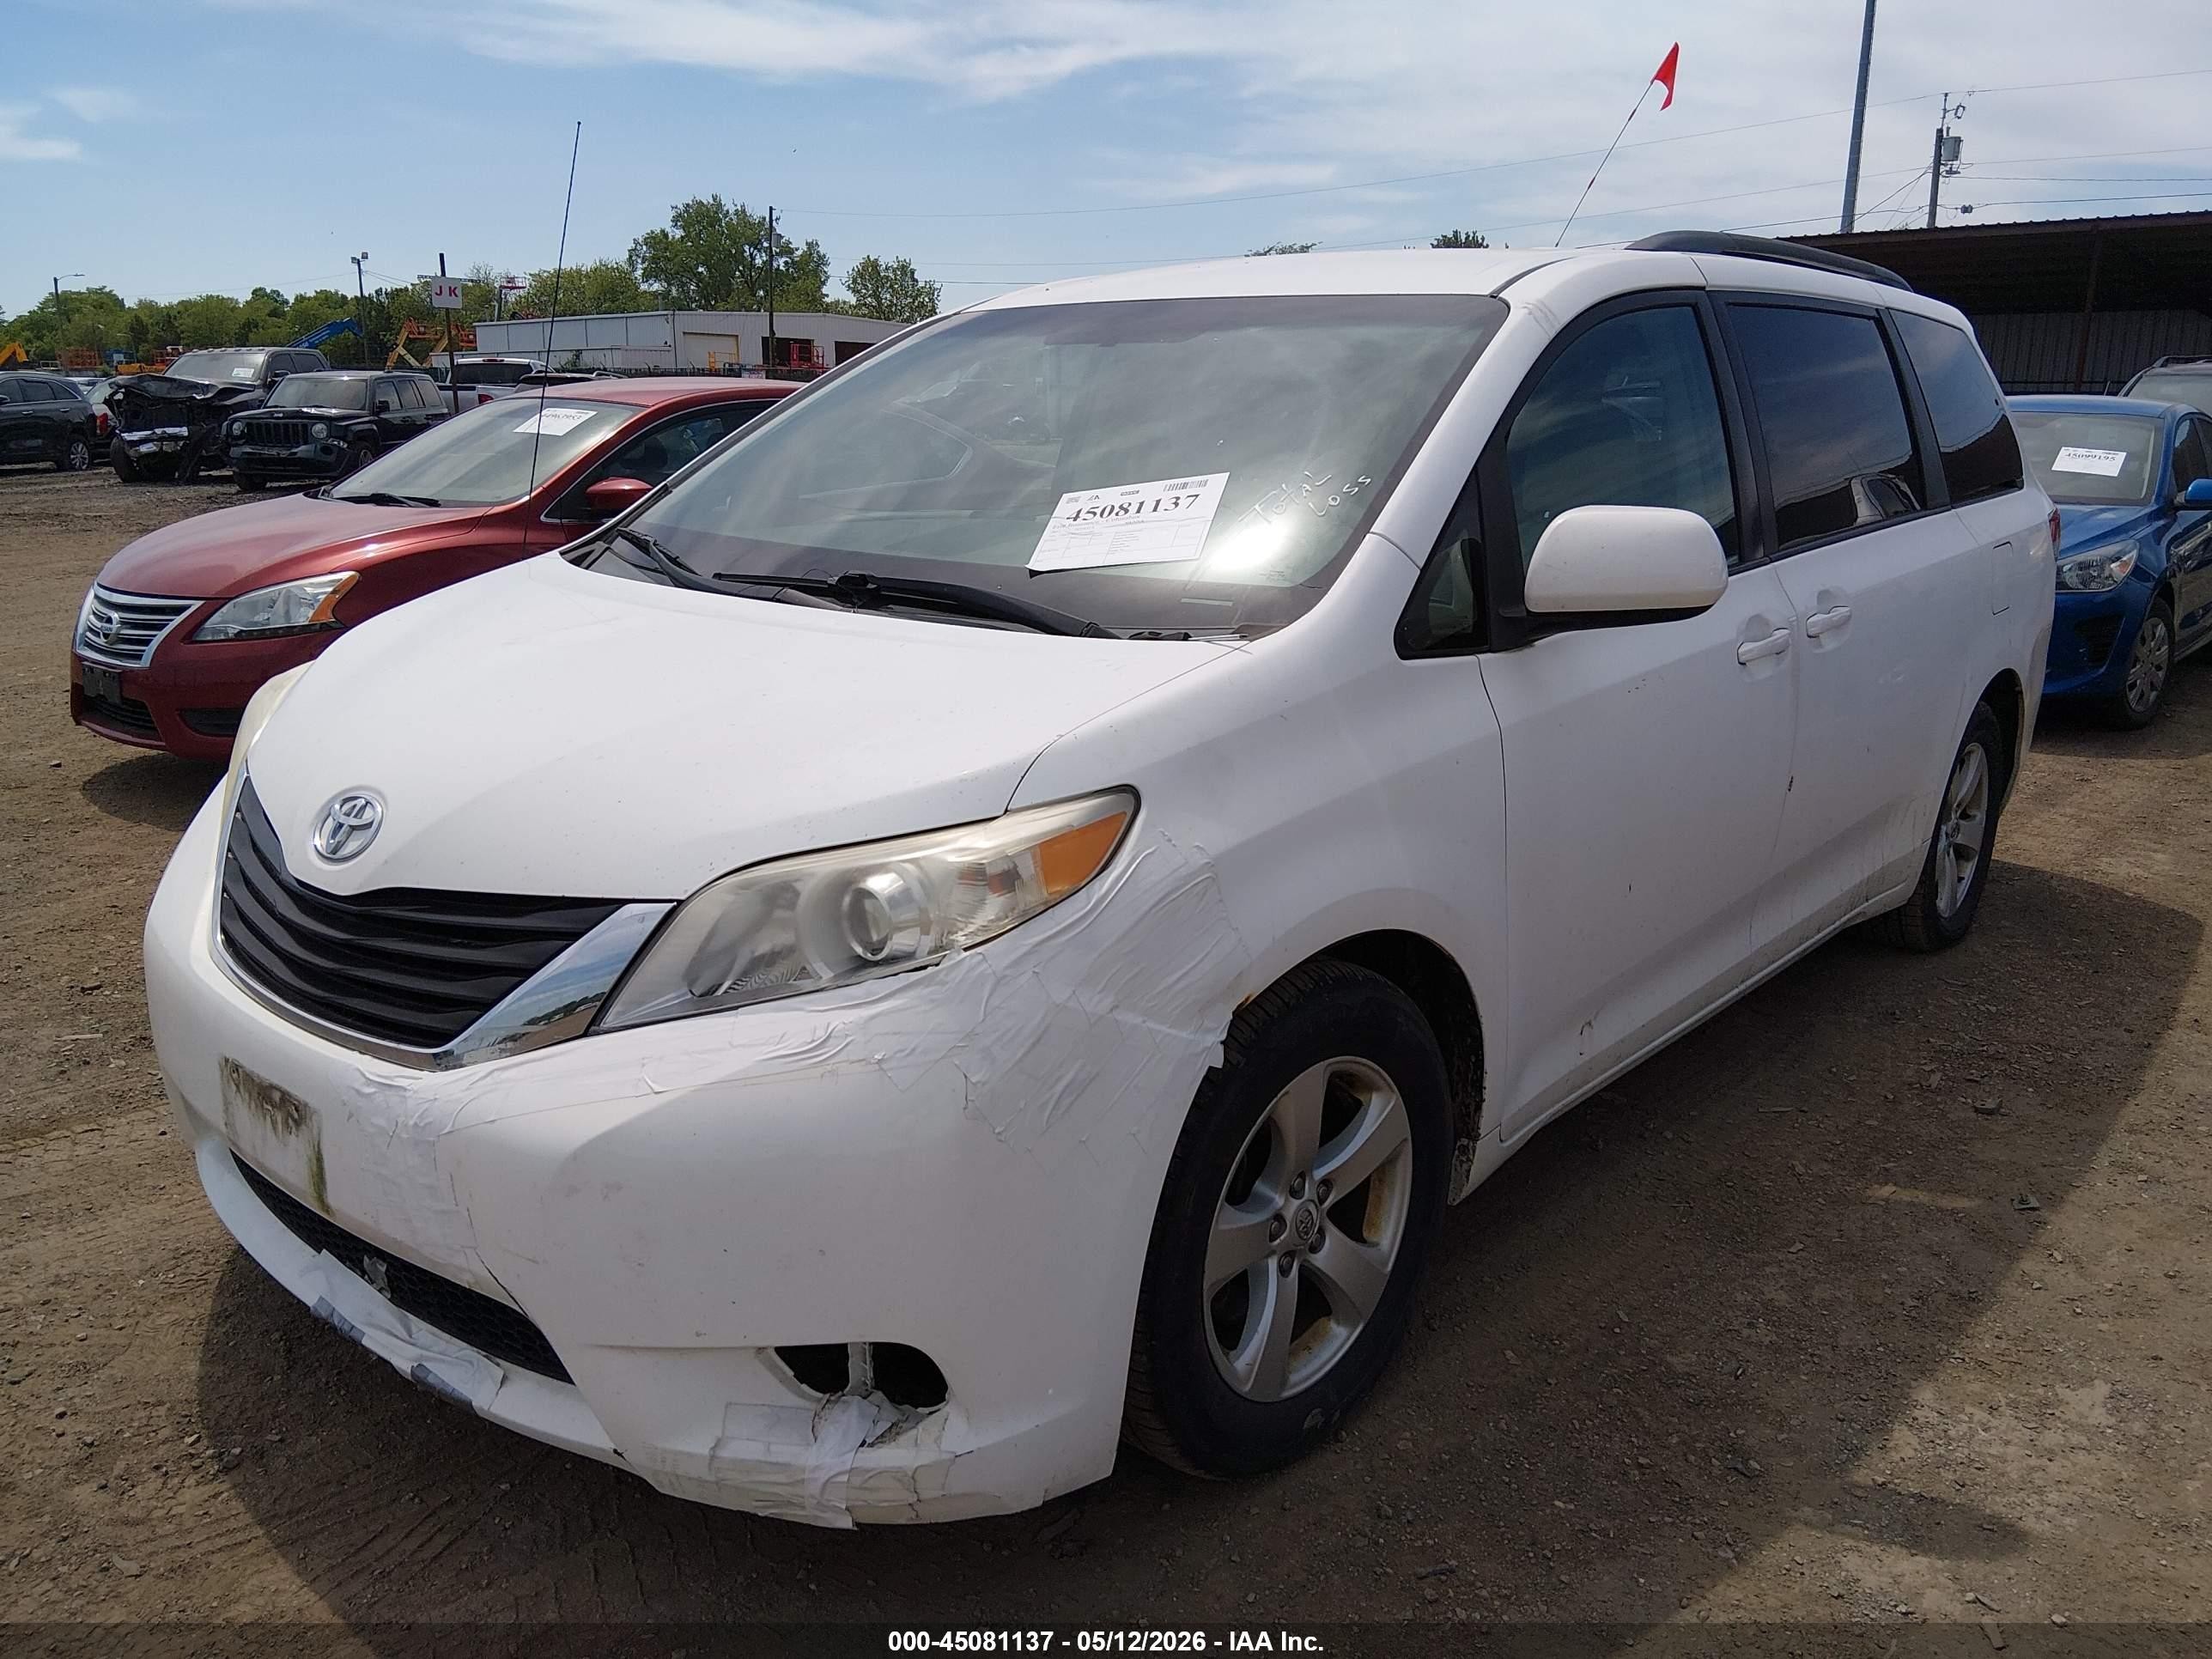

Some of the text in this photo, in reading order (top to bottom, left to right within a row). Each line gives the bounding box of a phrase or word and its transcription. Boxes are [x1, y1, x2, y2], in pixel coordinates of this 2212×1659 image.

[434, 285, 459, 298] J K
[1066, 494, 1200, 522] 45081137
[1308, 475, 1371, 517] LOSS
